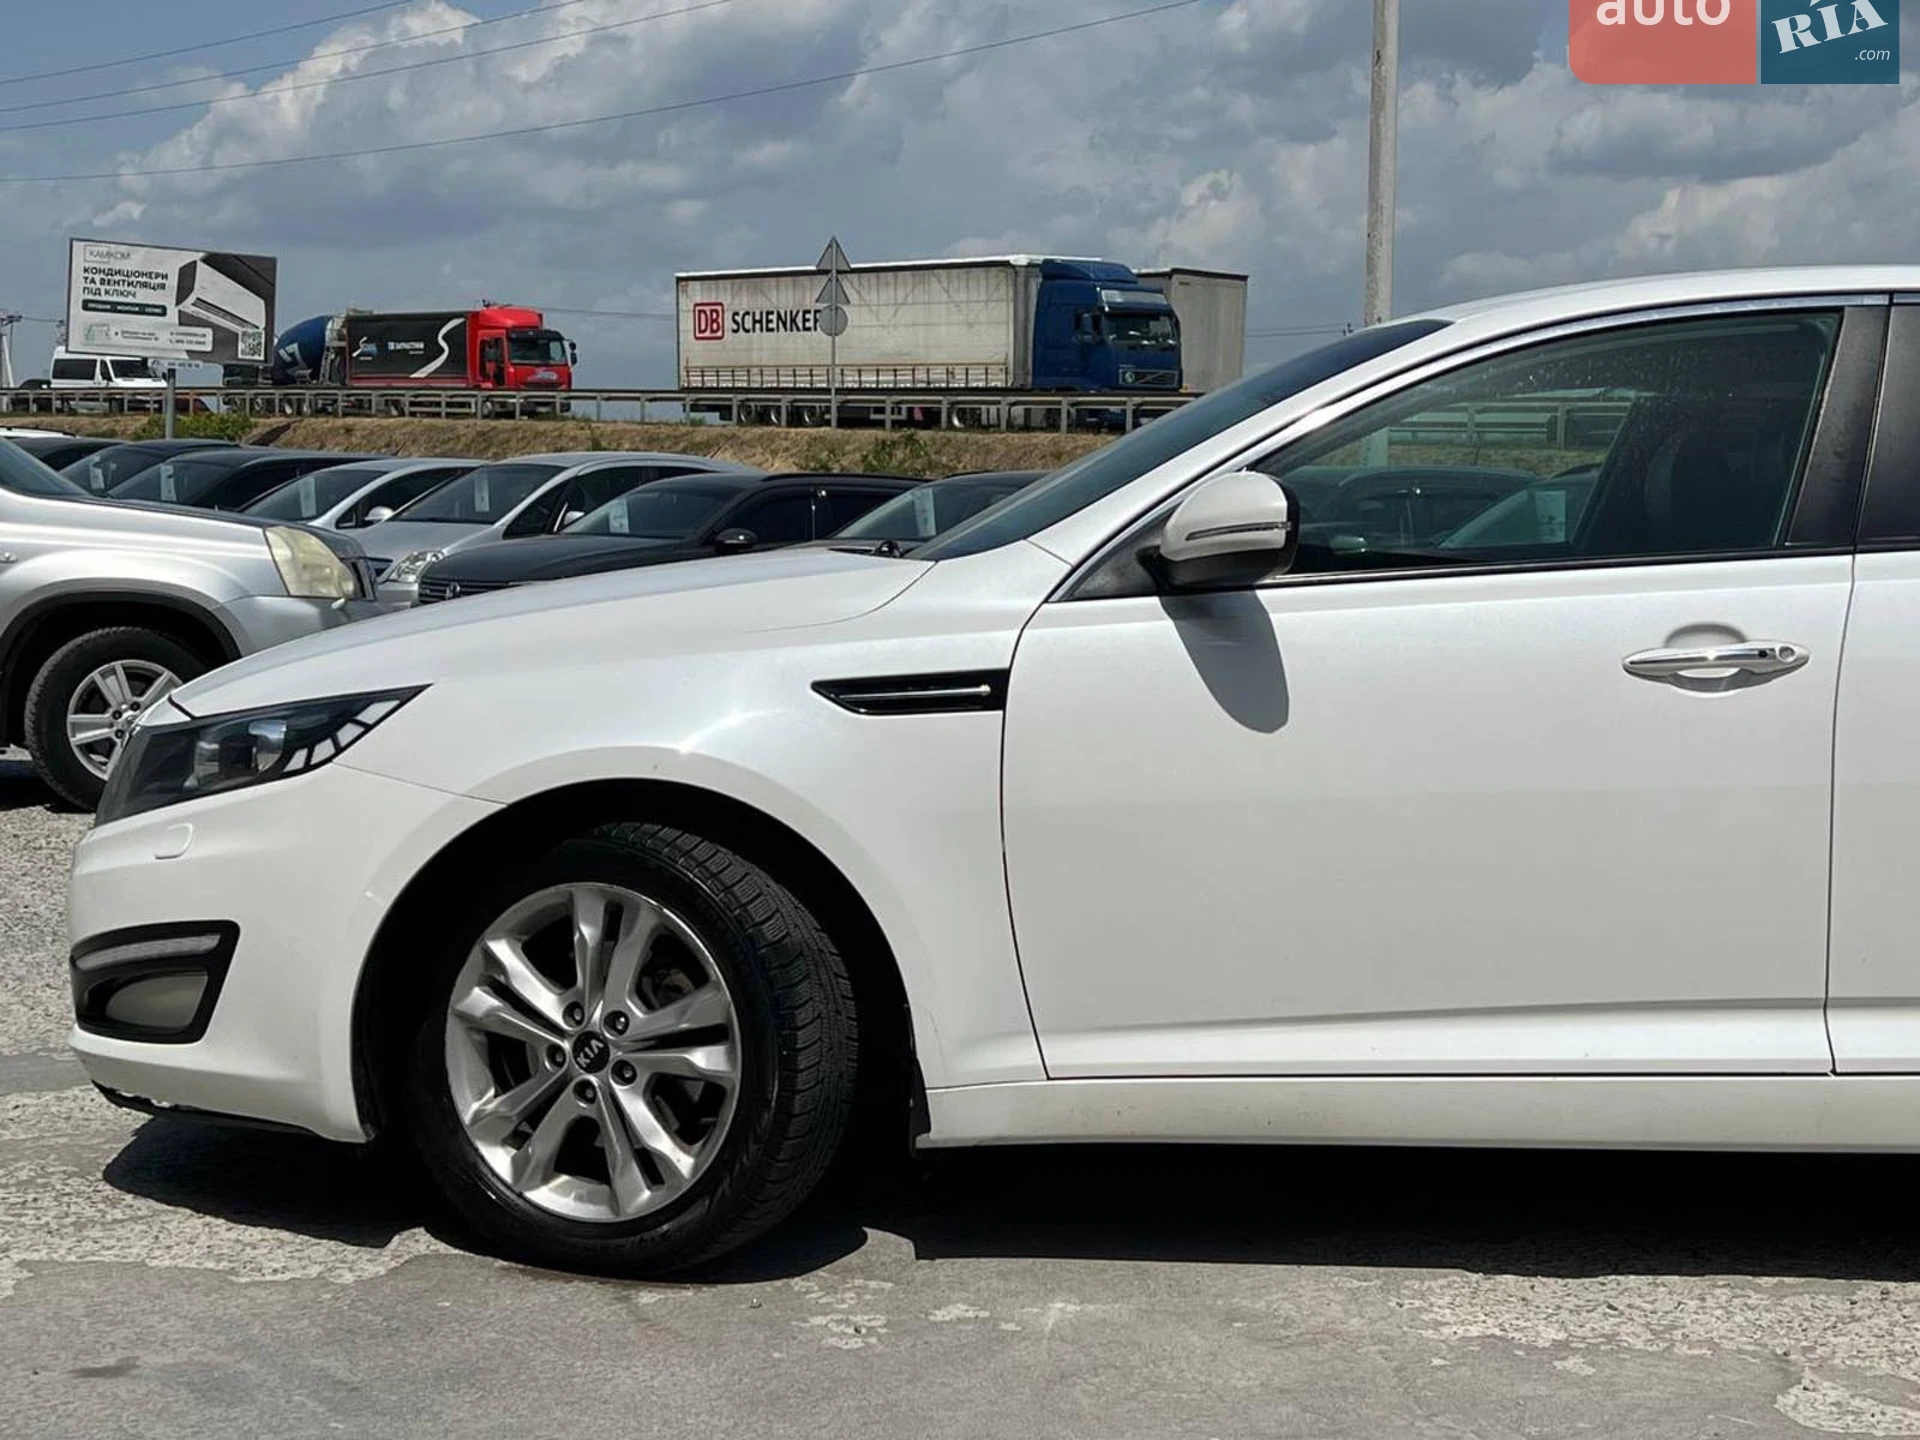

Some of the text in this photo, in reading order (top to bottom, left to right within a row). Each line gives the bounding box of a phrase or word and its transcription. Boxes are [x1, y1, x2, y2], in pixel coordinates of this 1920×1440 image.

[83, 265, 169, 281] КОНДИЦІОНЕРИ
[82, 276, 167, 292] ТА ВЕНТИЛЯЦІЯ
[82, 286, 137, 298] ПІД КЛЮЧ
[697, 309, 721, 334] DB
[576, 1038, 604, 1068] KIA
